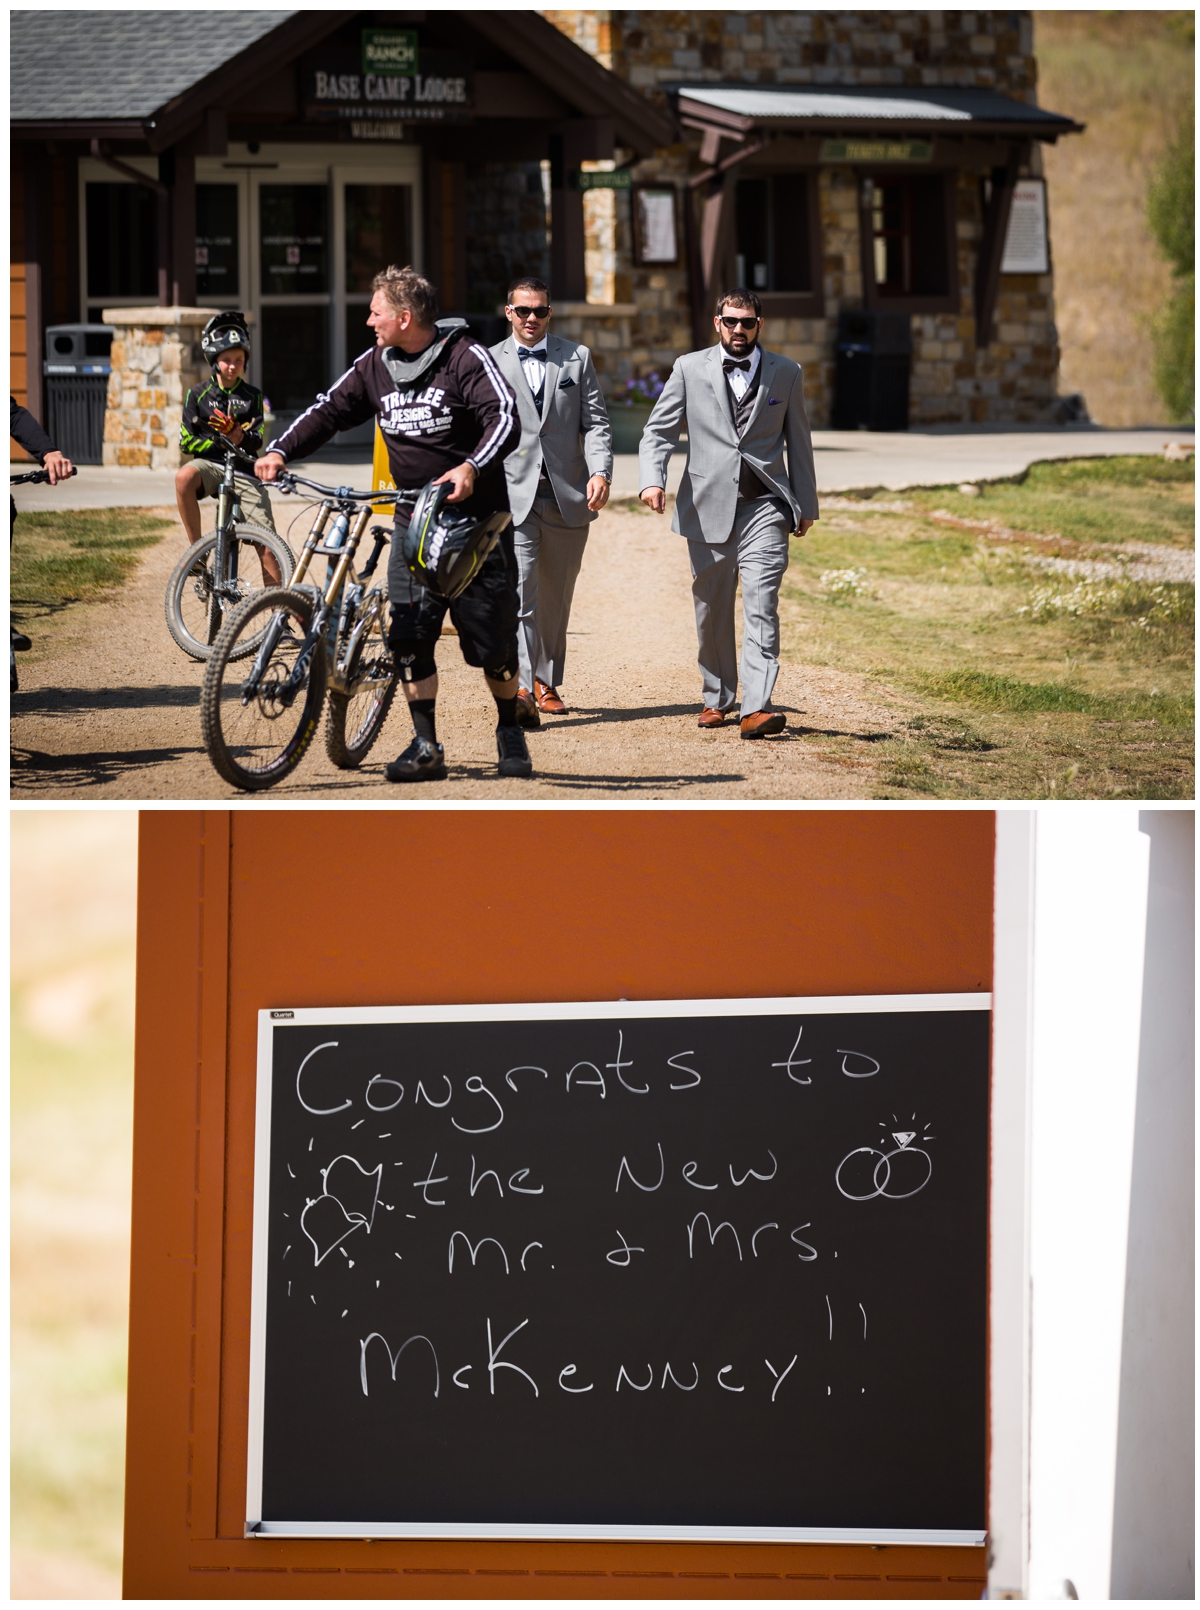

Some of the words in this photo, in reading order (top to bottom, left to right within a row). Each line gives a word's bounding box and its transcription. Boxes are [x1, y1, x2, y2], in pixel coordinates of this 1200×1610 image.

[366, 45, 414, 62] RANCH
[315, 71, 360, 99] BASE
[365, 73, 410, 101] CAMP
[414, 74, 466, 102] LODGE
[351, 121, 404, 139] WELCOME
[415, 387, 445, 408] LEE
[390, 406, 432, 423] DESIGNS
[773, 1026, 880, 1085] to
[413, 1151, 544, 1206] the
[615, 1142, 777, 1198] New
[448, 1231, 556, 1274] Mr.
[687, 1212, 838, 1261] Mrs.
